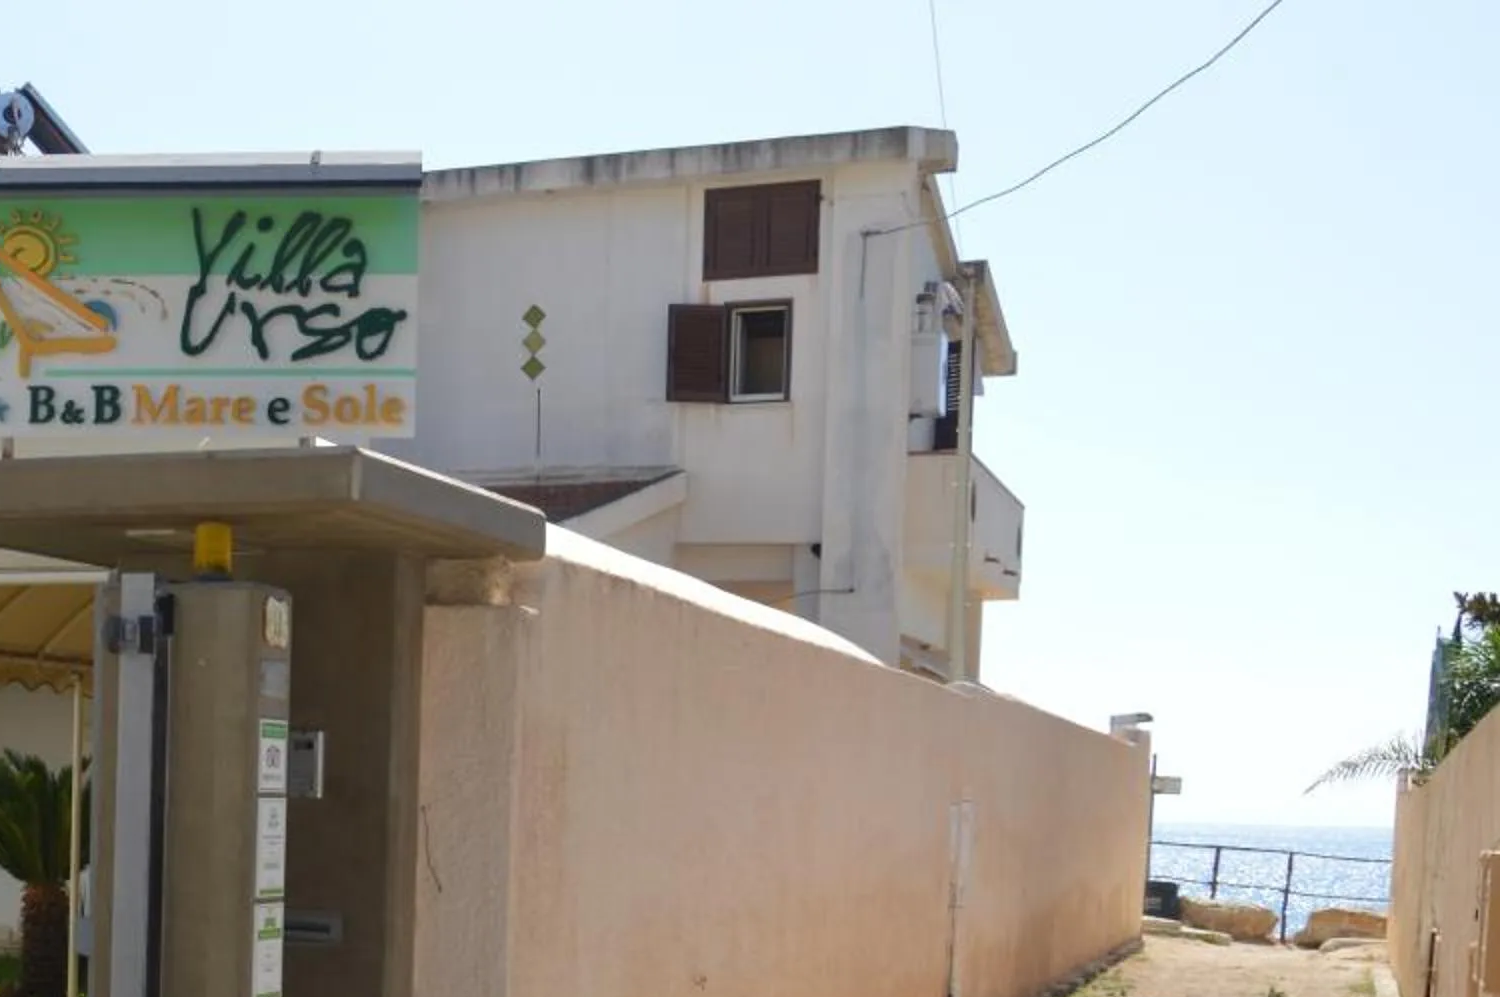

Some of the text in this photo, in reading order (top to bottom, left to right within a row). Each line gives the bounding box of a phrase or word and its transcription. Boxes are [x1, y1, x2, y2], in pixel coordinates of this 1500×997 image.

[191, 207, 367, 298] Villa
[180, 286, 407, 362] Urso
[27, 384, 406, 425] B&B Mare e Sole
